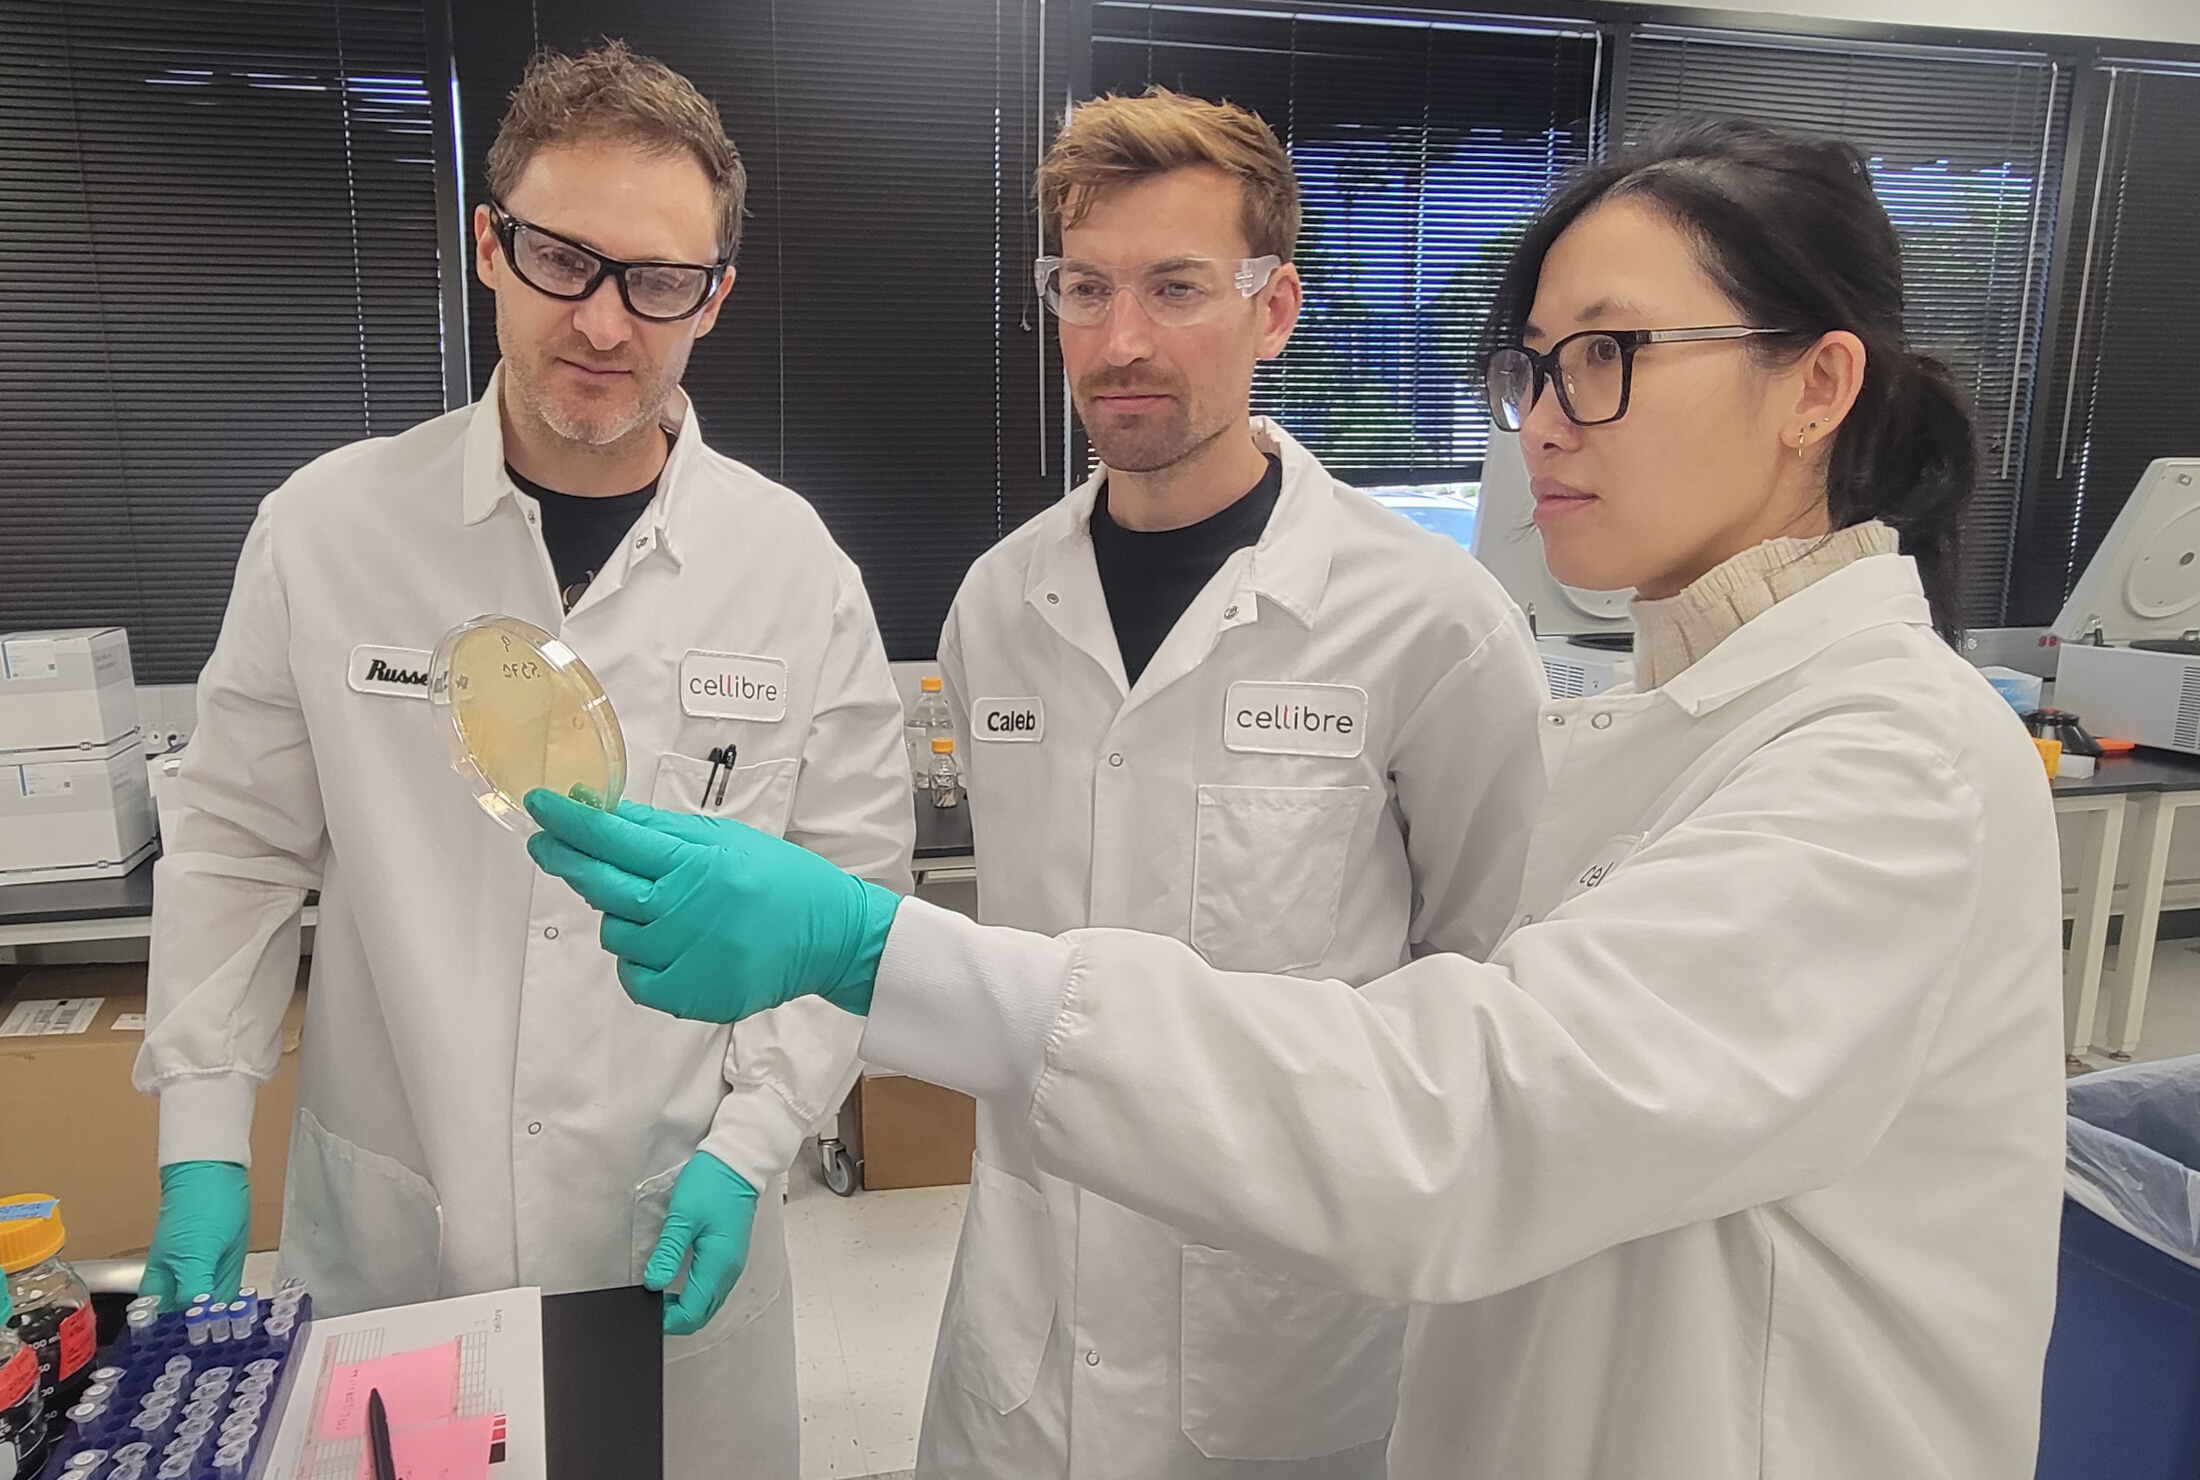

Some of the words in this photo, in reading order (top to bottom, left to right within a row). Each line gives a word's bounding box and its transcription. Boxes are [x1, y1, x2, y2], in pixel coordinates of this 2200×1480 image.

[365, 658, 428, 686] Russe
[689, 673, 777, 702] cellibre
[987, 709, 1036, 732] Caleb
[1236, 704, 1354, 734] cellibre
[1579, 861, 1615, 887] cel
